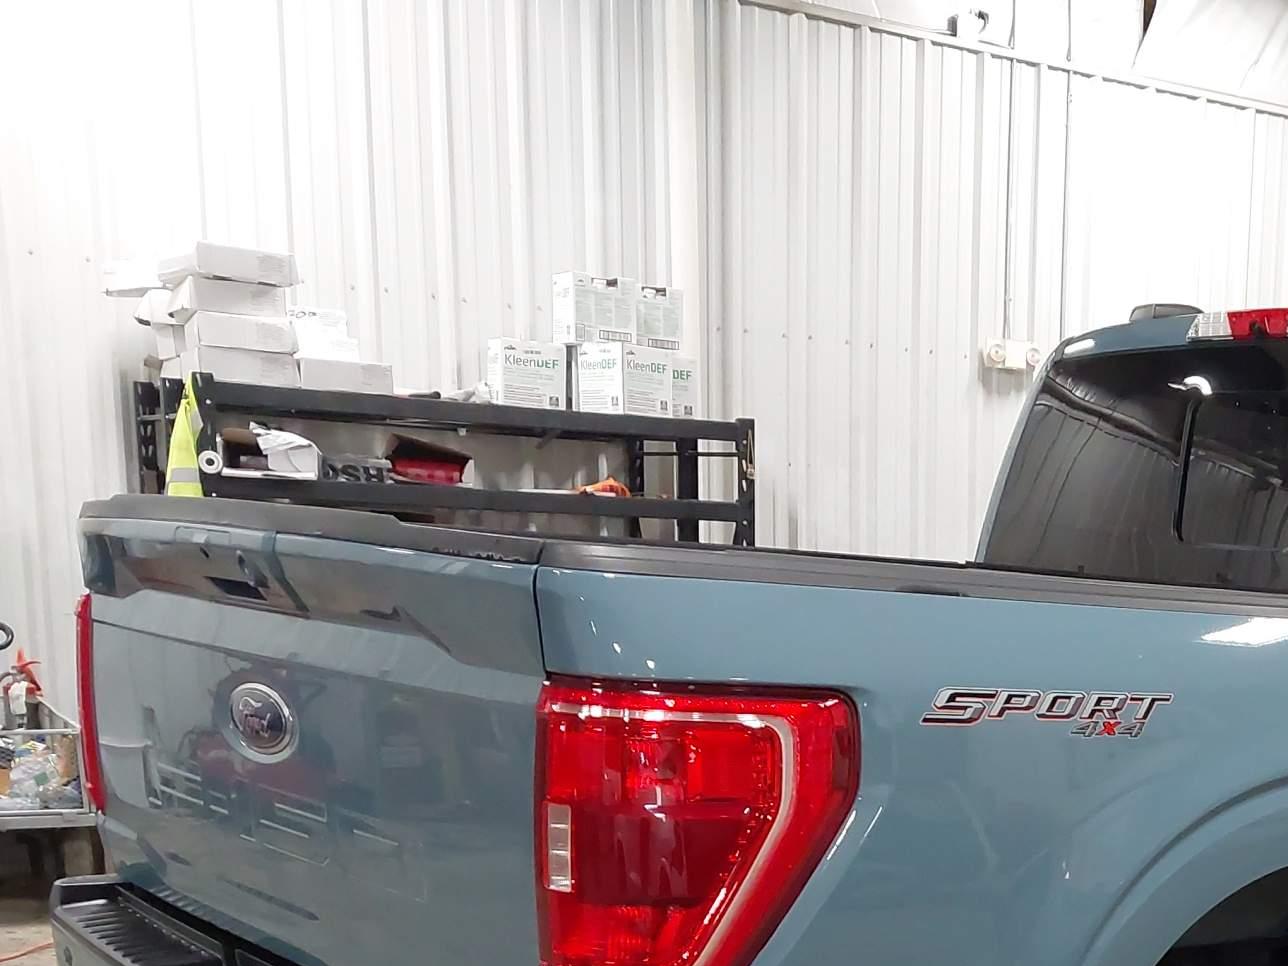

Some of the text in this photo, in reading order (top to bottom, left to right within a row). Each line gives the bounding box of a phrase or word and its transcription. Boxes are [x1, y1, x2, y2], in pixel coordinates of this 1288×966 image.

[504, 353, 560, 369] KleenDEF
[580, 358, 617, 370] KleenDEF
[626, 359, 667, 374] KleenDEF
[920, 686, 1175, 727] SPORT
